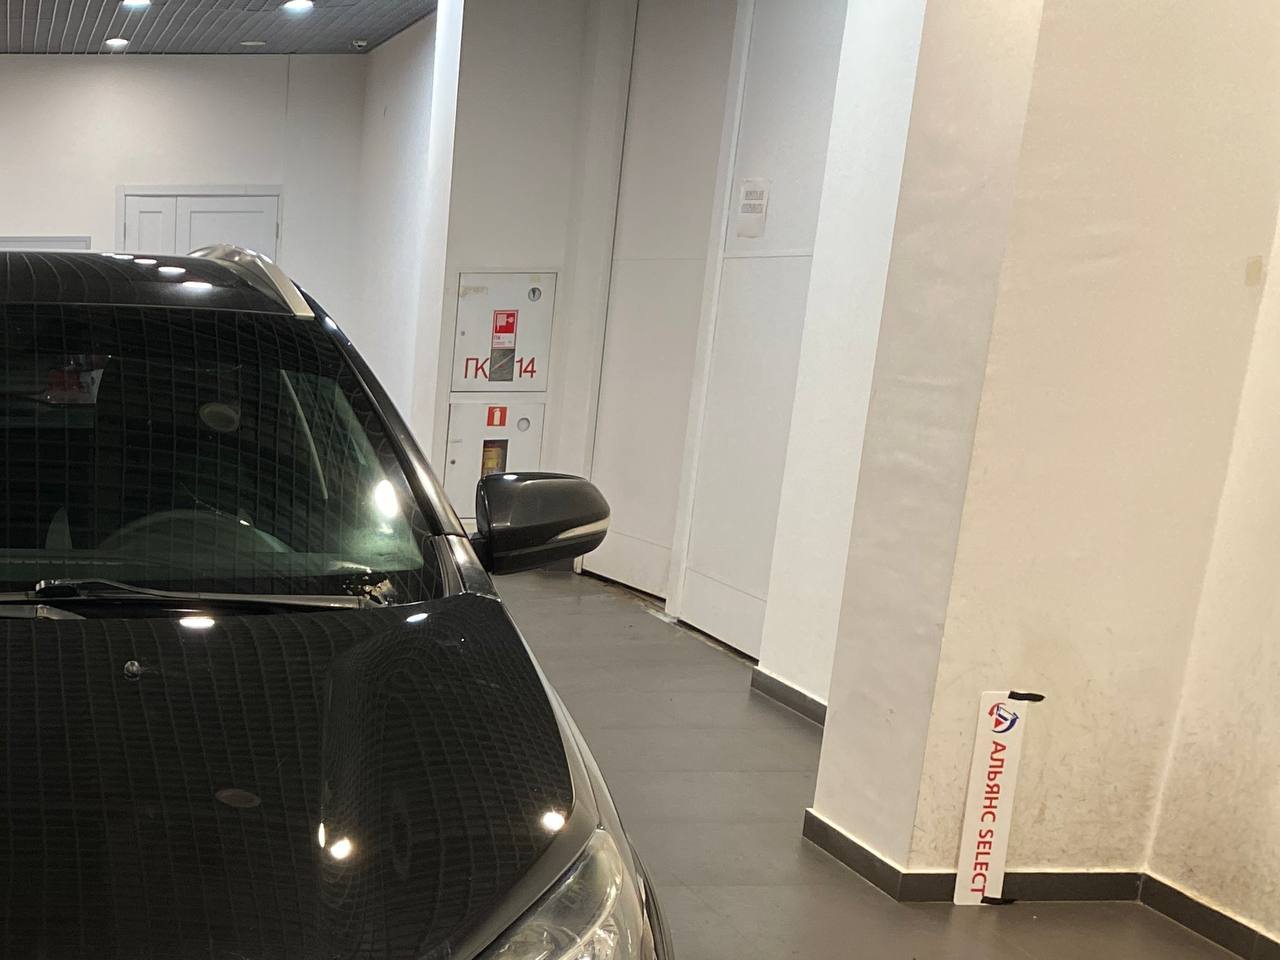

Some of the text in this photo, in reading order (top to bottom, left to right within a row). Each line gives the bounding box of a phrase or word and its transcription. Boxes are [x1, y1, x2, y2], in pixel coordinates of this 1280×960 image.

[463, 357, 537, 379] ПК 14
[970, 740, 1007, 895] АЛЬЯНС SELECT
